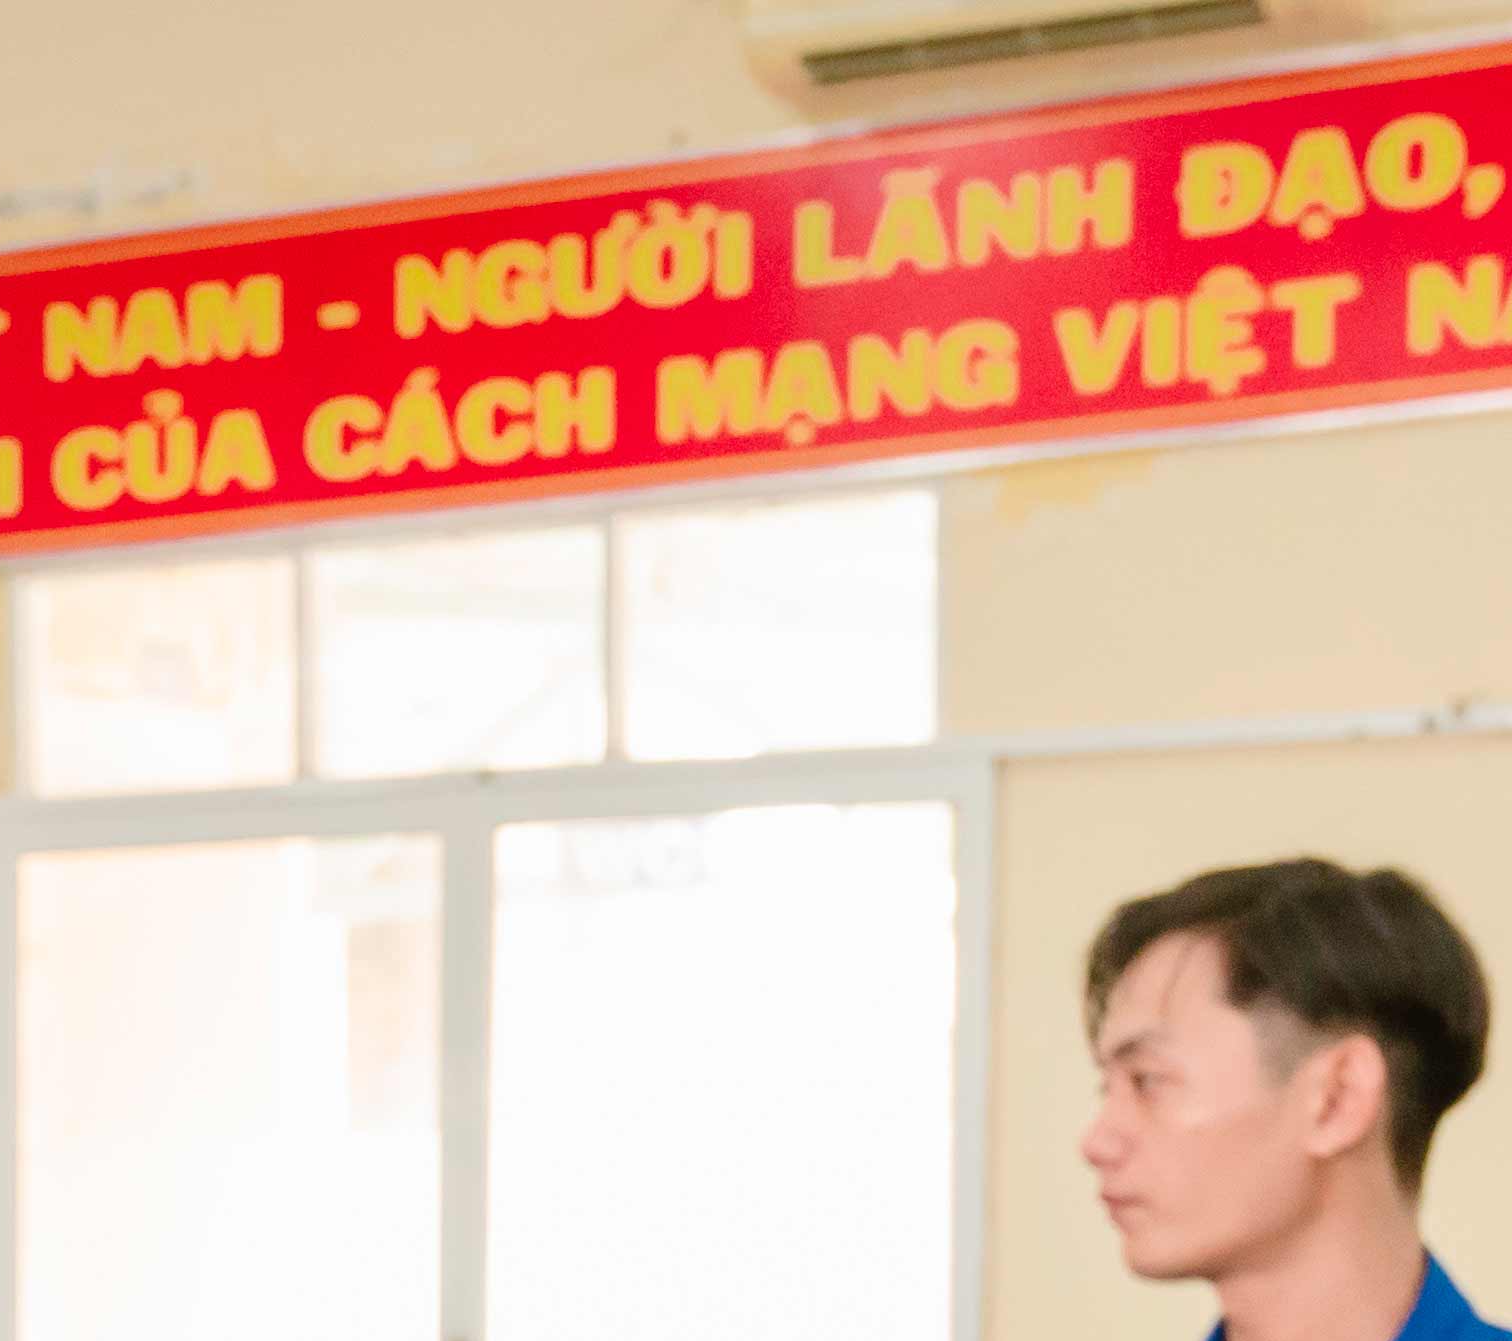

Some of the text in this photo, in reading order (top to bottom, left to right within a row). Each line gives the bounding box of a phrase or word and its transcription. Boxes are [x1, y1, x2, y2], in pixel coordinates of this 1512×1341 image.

[45, 275, 282, 381] NAM
[317, 301, 360, 331] -
[394, 201, 753, 339] NGƯỜI
[792, 168, 1133, 289] LÃNH
[1176, 113, 1504, 240] ĐẠO,
[52, 389, 275, 510] CỦA
[304, 366, 616, 483] CÁCH
[656, 318, 1020, 445] MẠNG
[1052, 265, 1362, 396] VIỆT
